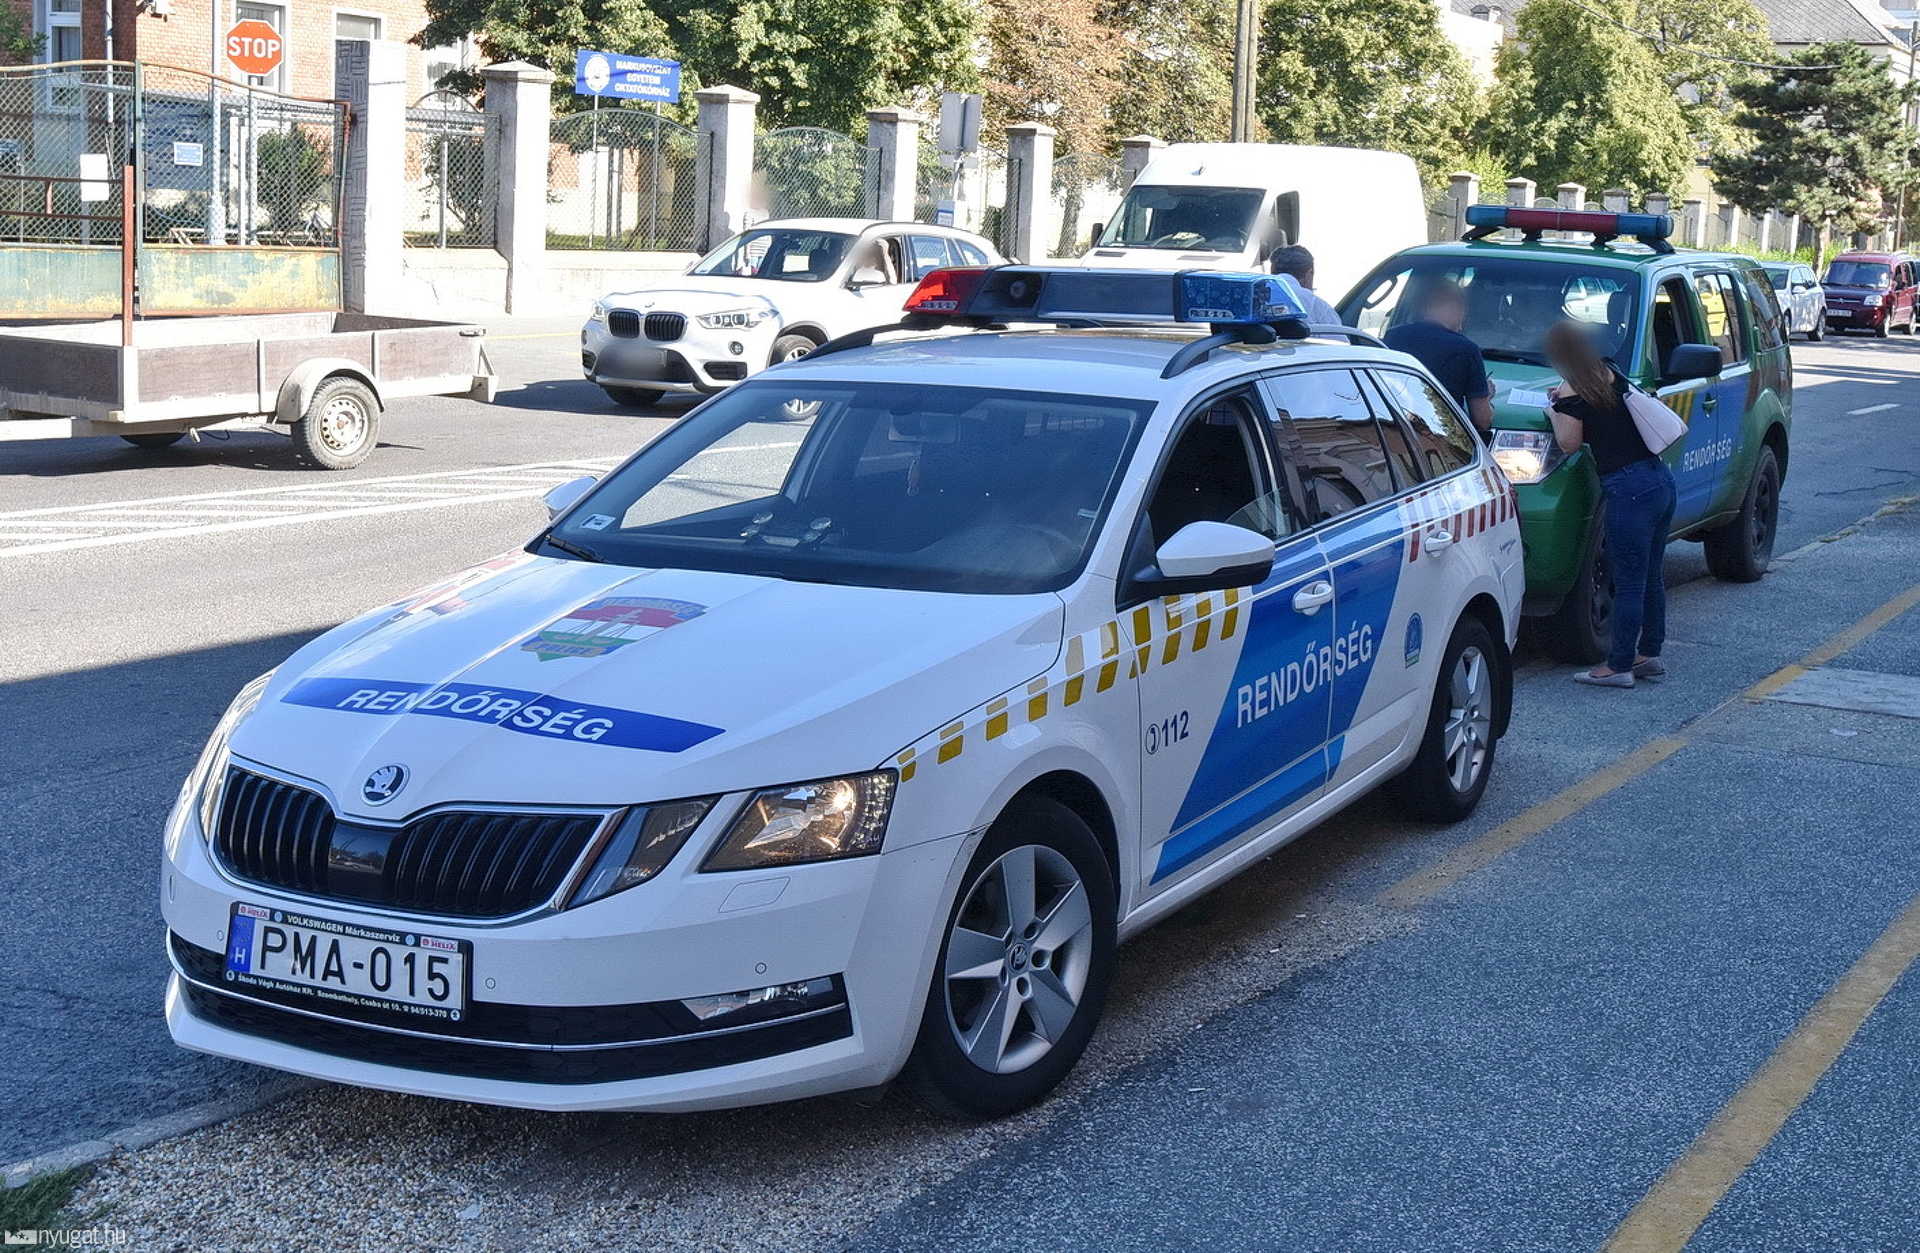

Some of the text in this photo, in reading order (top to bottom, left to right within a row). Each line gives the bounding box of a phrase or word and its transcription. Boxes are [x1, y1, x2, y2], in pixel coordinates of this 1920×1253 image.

[228, 36, 281, 59] STOP
[1236, 620, 1372, 728] RENDŐRSÉG
[336, 689, 614, 742] RENDŐRSÉG
[1161, 709, 1189, 747] 112
[286, 914, 344, 933] VOLKSWAGEN
[234, 947, 246, 965] H
[259, 925, 450, 1001] PMA-015
